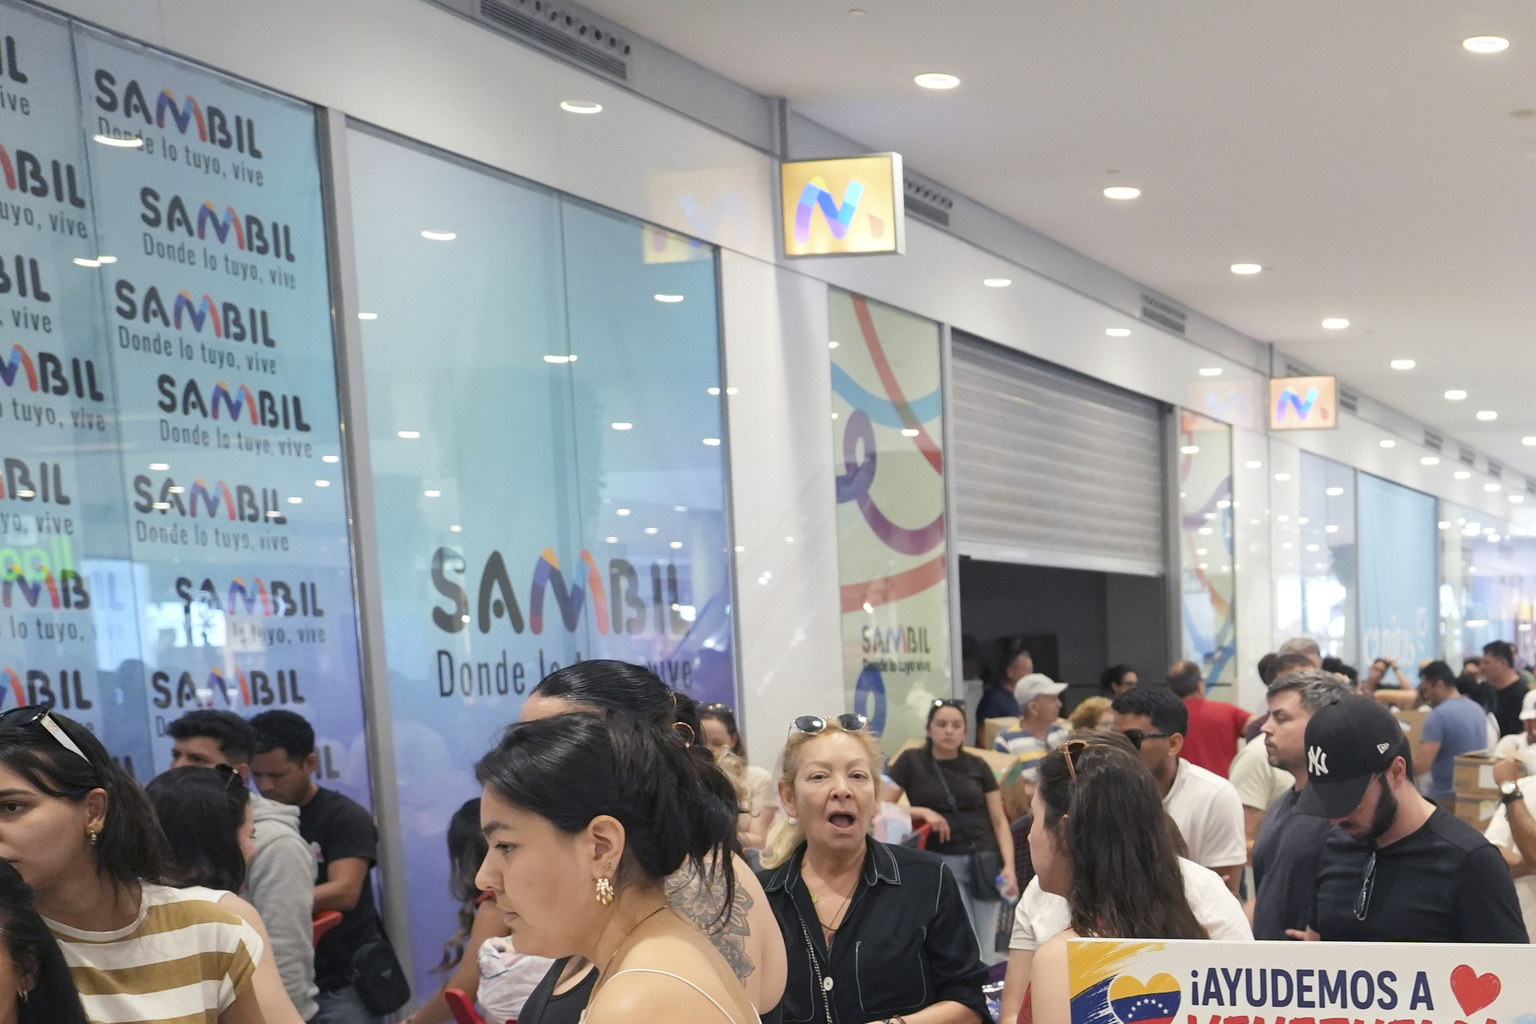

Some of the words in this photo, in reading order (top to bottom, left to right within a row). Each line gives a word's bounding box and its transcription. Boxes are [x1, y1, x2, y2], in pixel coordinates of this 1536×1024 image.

[94, 68, 262, 159] SAMBIL
[139, 186, 296, 262] SAMBIL
[143, 233, 196, 264] Donde
[203, 248, 217, 271] lo
[269, 267, 296, 290] vive
[114, 279, 276, 348] SAMBIL
[119, 326, 172, 357] Donde
[178, 339, 193, 361] lo
[200, 344, 241, 372] tuyo,
[246, 355, 277, 375] vive
[157, 374, 312, 432] SAMBIL
[160, 419, 210, 447] Donde
[216, 427, 230, 449] lo
[238, 433, 274, 457] tuyo,
[278, 440, 312, 458] vive
[133, 474, 287, 525] SAMBIL
[431, 547, 691, 635] SAMBIL
[862, 624, 930, 654] SAMBIL
[152, 668, 305, 709] SAMBIL
[437, 650, 525, 698] Donde
[1308, 745, 1329, 776] NY
[1191, 967, 1397, 1010] ¡AYUDEMOS
[1410, 971, 1434, 1010] A
